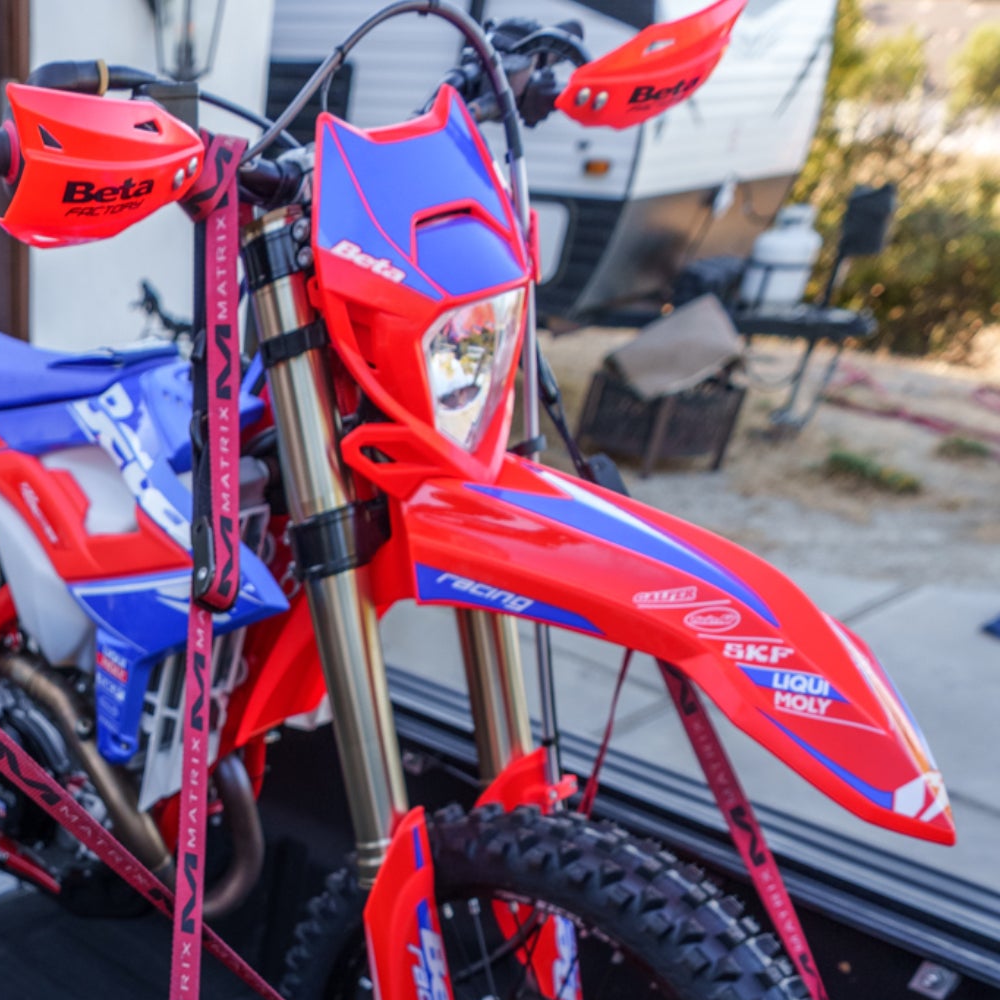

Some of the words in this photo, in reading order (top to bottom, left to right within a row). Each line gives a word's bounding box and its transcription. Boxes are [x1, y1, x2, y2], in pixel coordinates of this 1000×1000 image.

[627, 76, 701, 105] Beta
[61, 177, 155, 204] Beta
[63, 199, 145, 217] FACTORY
[215, 215, 229, 321] MATRIX
[330, 238, 407, 284] Beta
[218, 406, 231, 512] MATRIX
[435, 571, 535, 613] racing
[722, 642, 795, 664] SKF
[771, 672, 830, 697] LIQUI
[773, 690, 832, 716] MOLY
[187, 736, 202, 850] MATRIX
[58, 803, 149, 886] MATRIX
